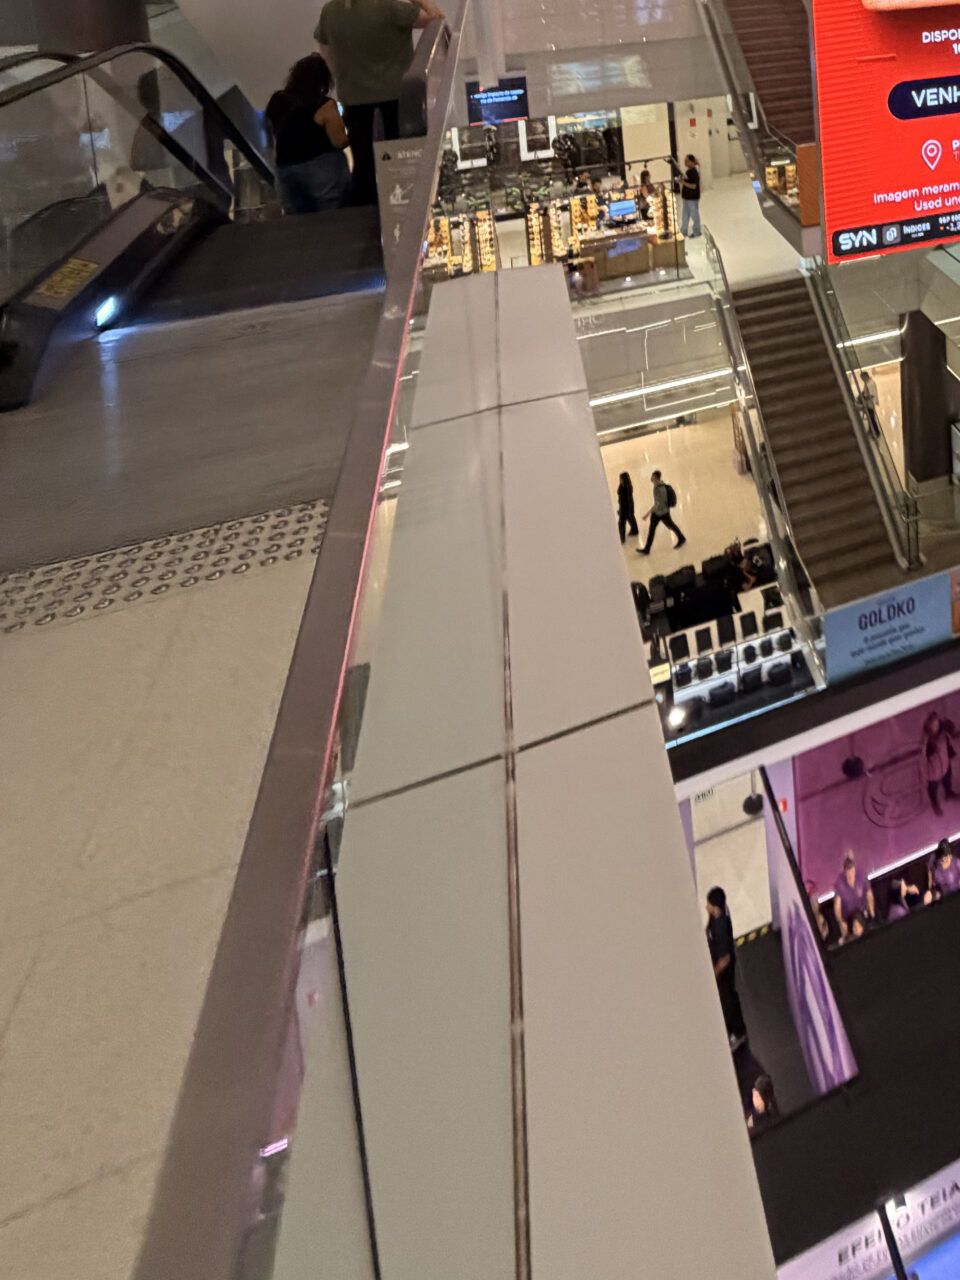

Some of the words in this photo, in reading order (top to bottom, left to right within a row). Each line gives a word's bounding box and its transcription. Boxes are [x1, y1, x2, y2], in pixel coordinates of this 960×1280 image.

[838, 228, 877, 251] SYN
[858, 596, 916, 631] GOLDKO
[838, 1212, 910, 1266] EFEIO
